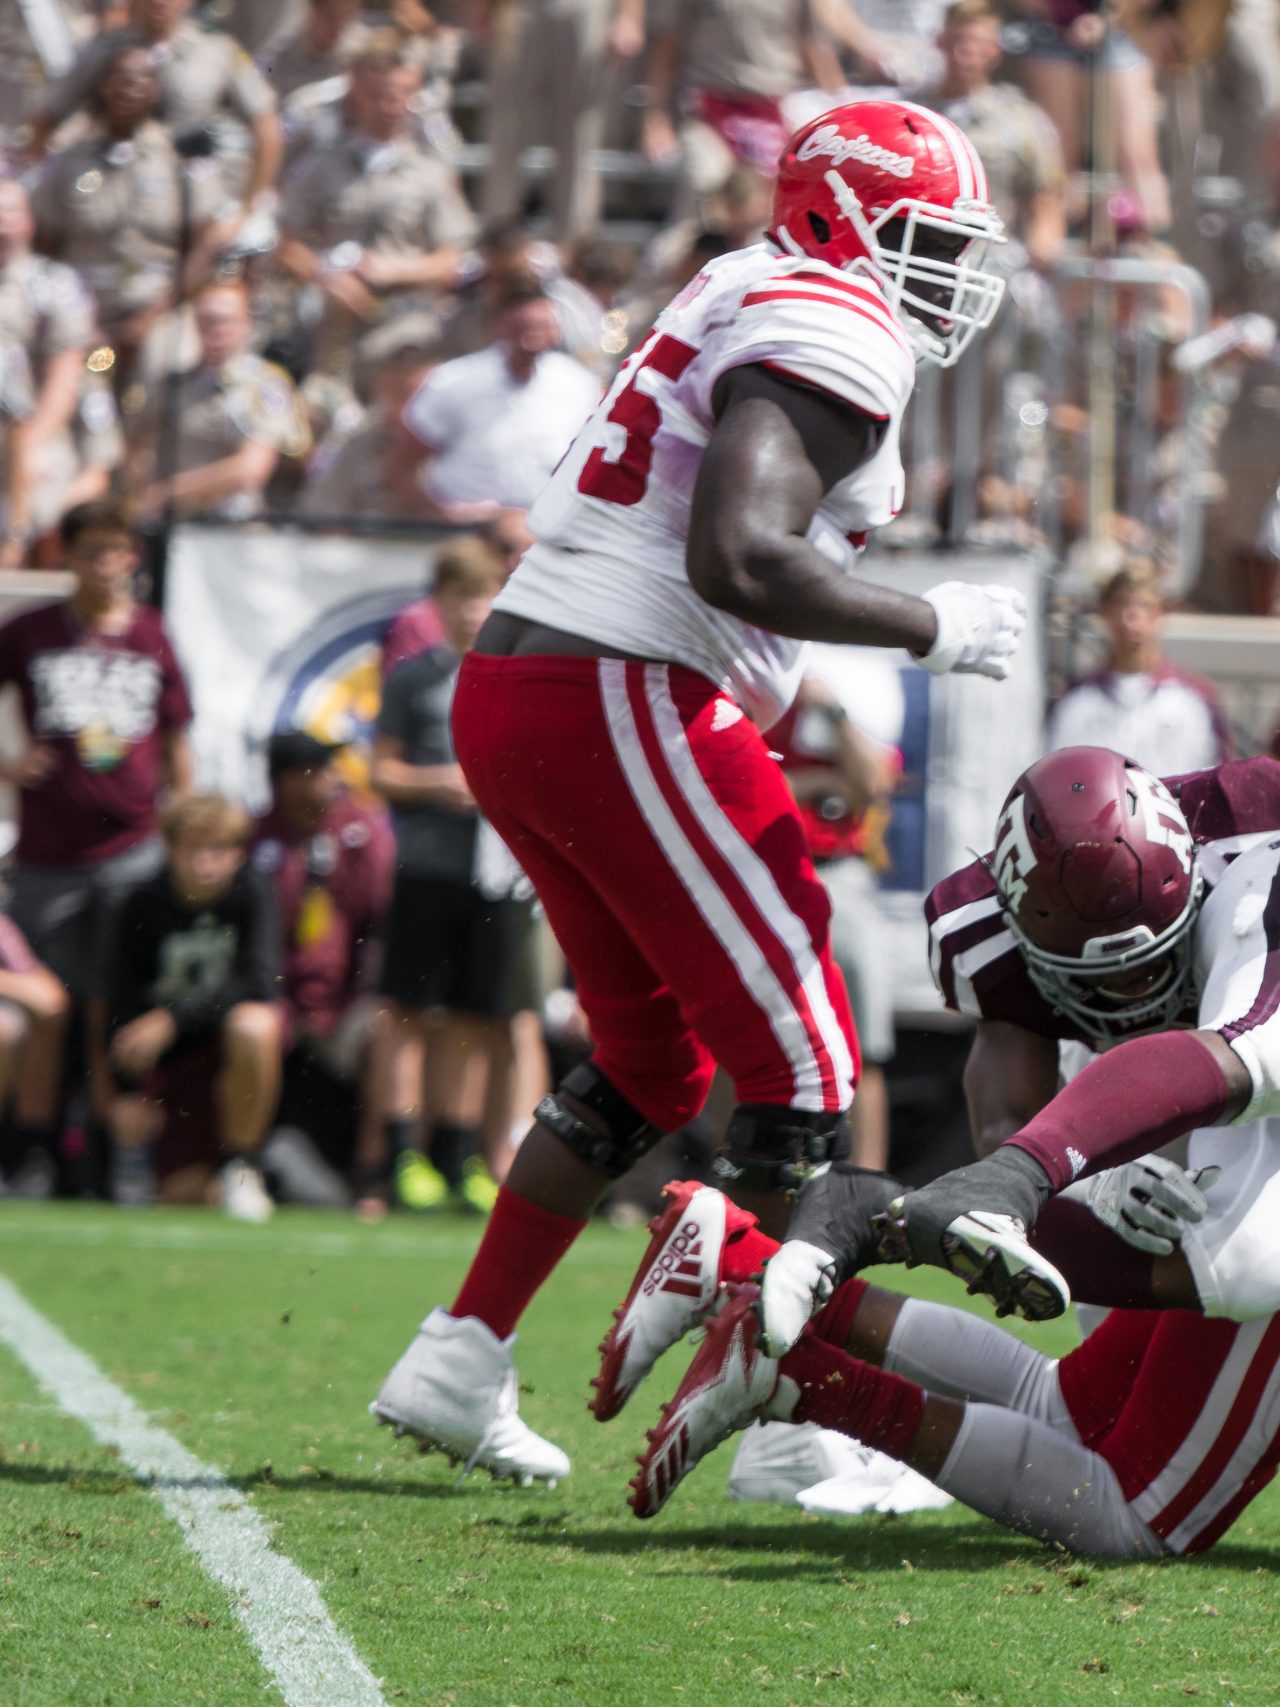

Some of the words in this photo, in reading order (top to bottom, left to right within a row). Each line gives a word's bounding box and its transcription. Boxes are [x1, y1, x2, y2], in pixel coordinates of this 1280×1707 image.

[797, 124, 915, 179] Cajuns
[552, 327, 701, 506] 5
[643, 1222, 700, 1297] adidas
